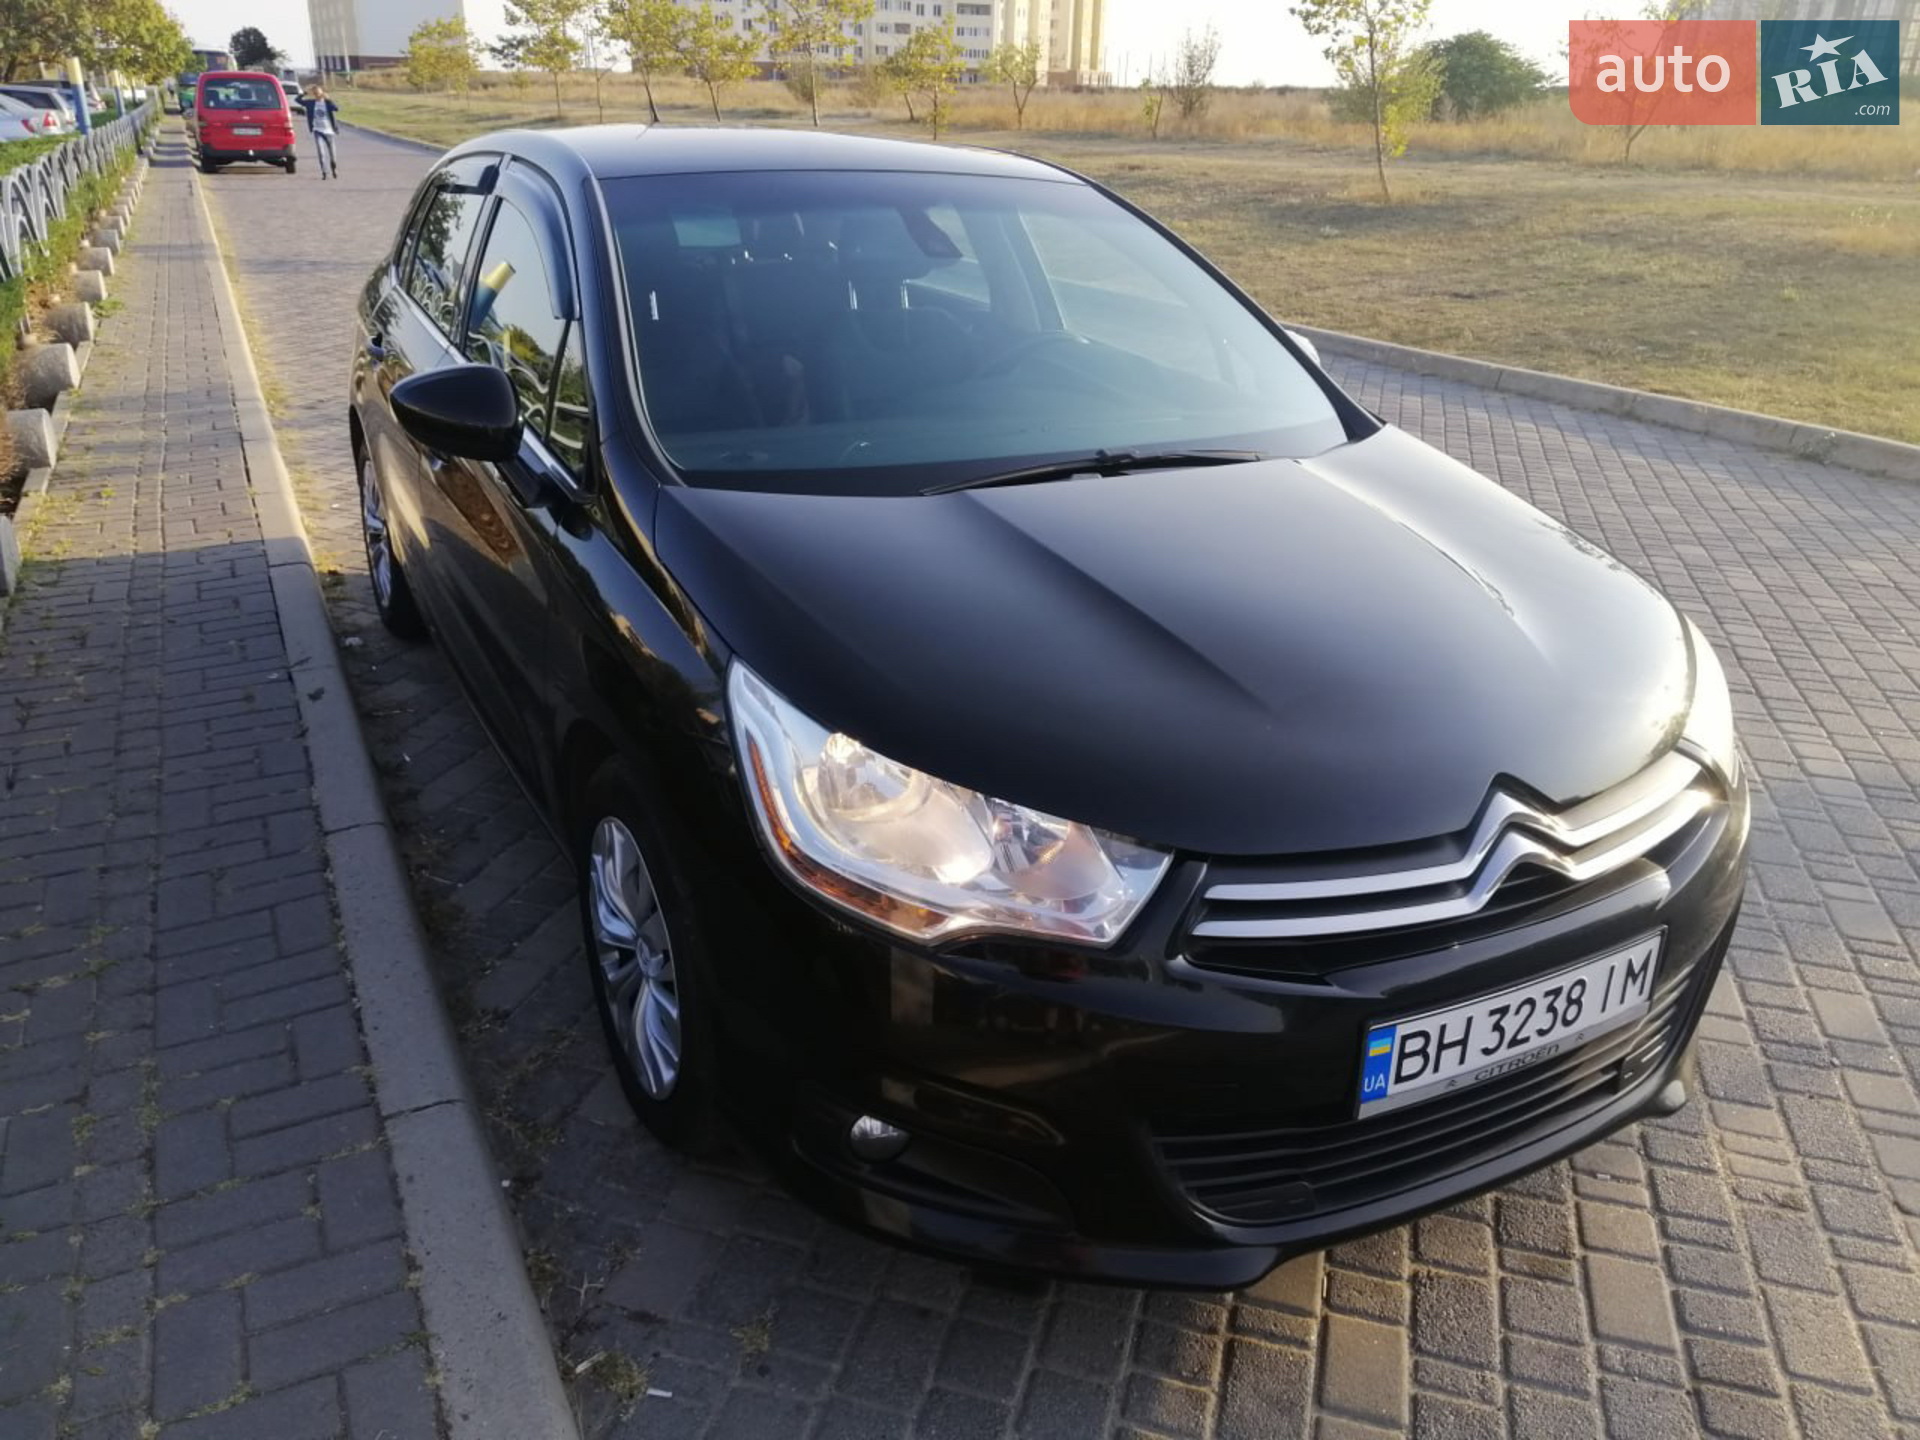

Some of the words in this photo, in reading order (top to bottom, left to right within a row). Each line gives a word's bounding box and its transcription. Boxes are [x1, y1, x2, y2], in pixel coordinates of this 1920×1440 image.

[1394, 1016, 1473, 1085] BH
[1480, 978, 1588, 1057] 3238
[1601, 948, 1652, 1014] IM
[1363, 1072, 1386, 1093] UA
